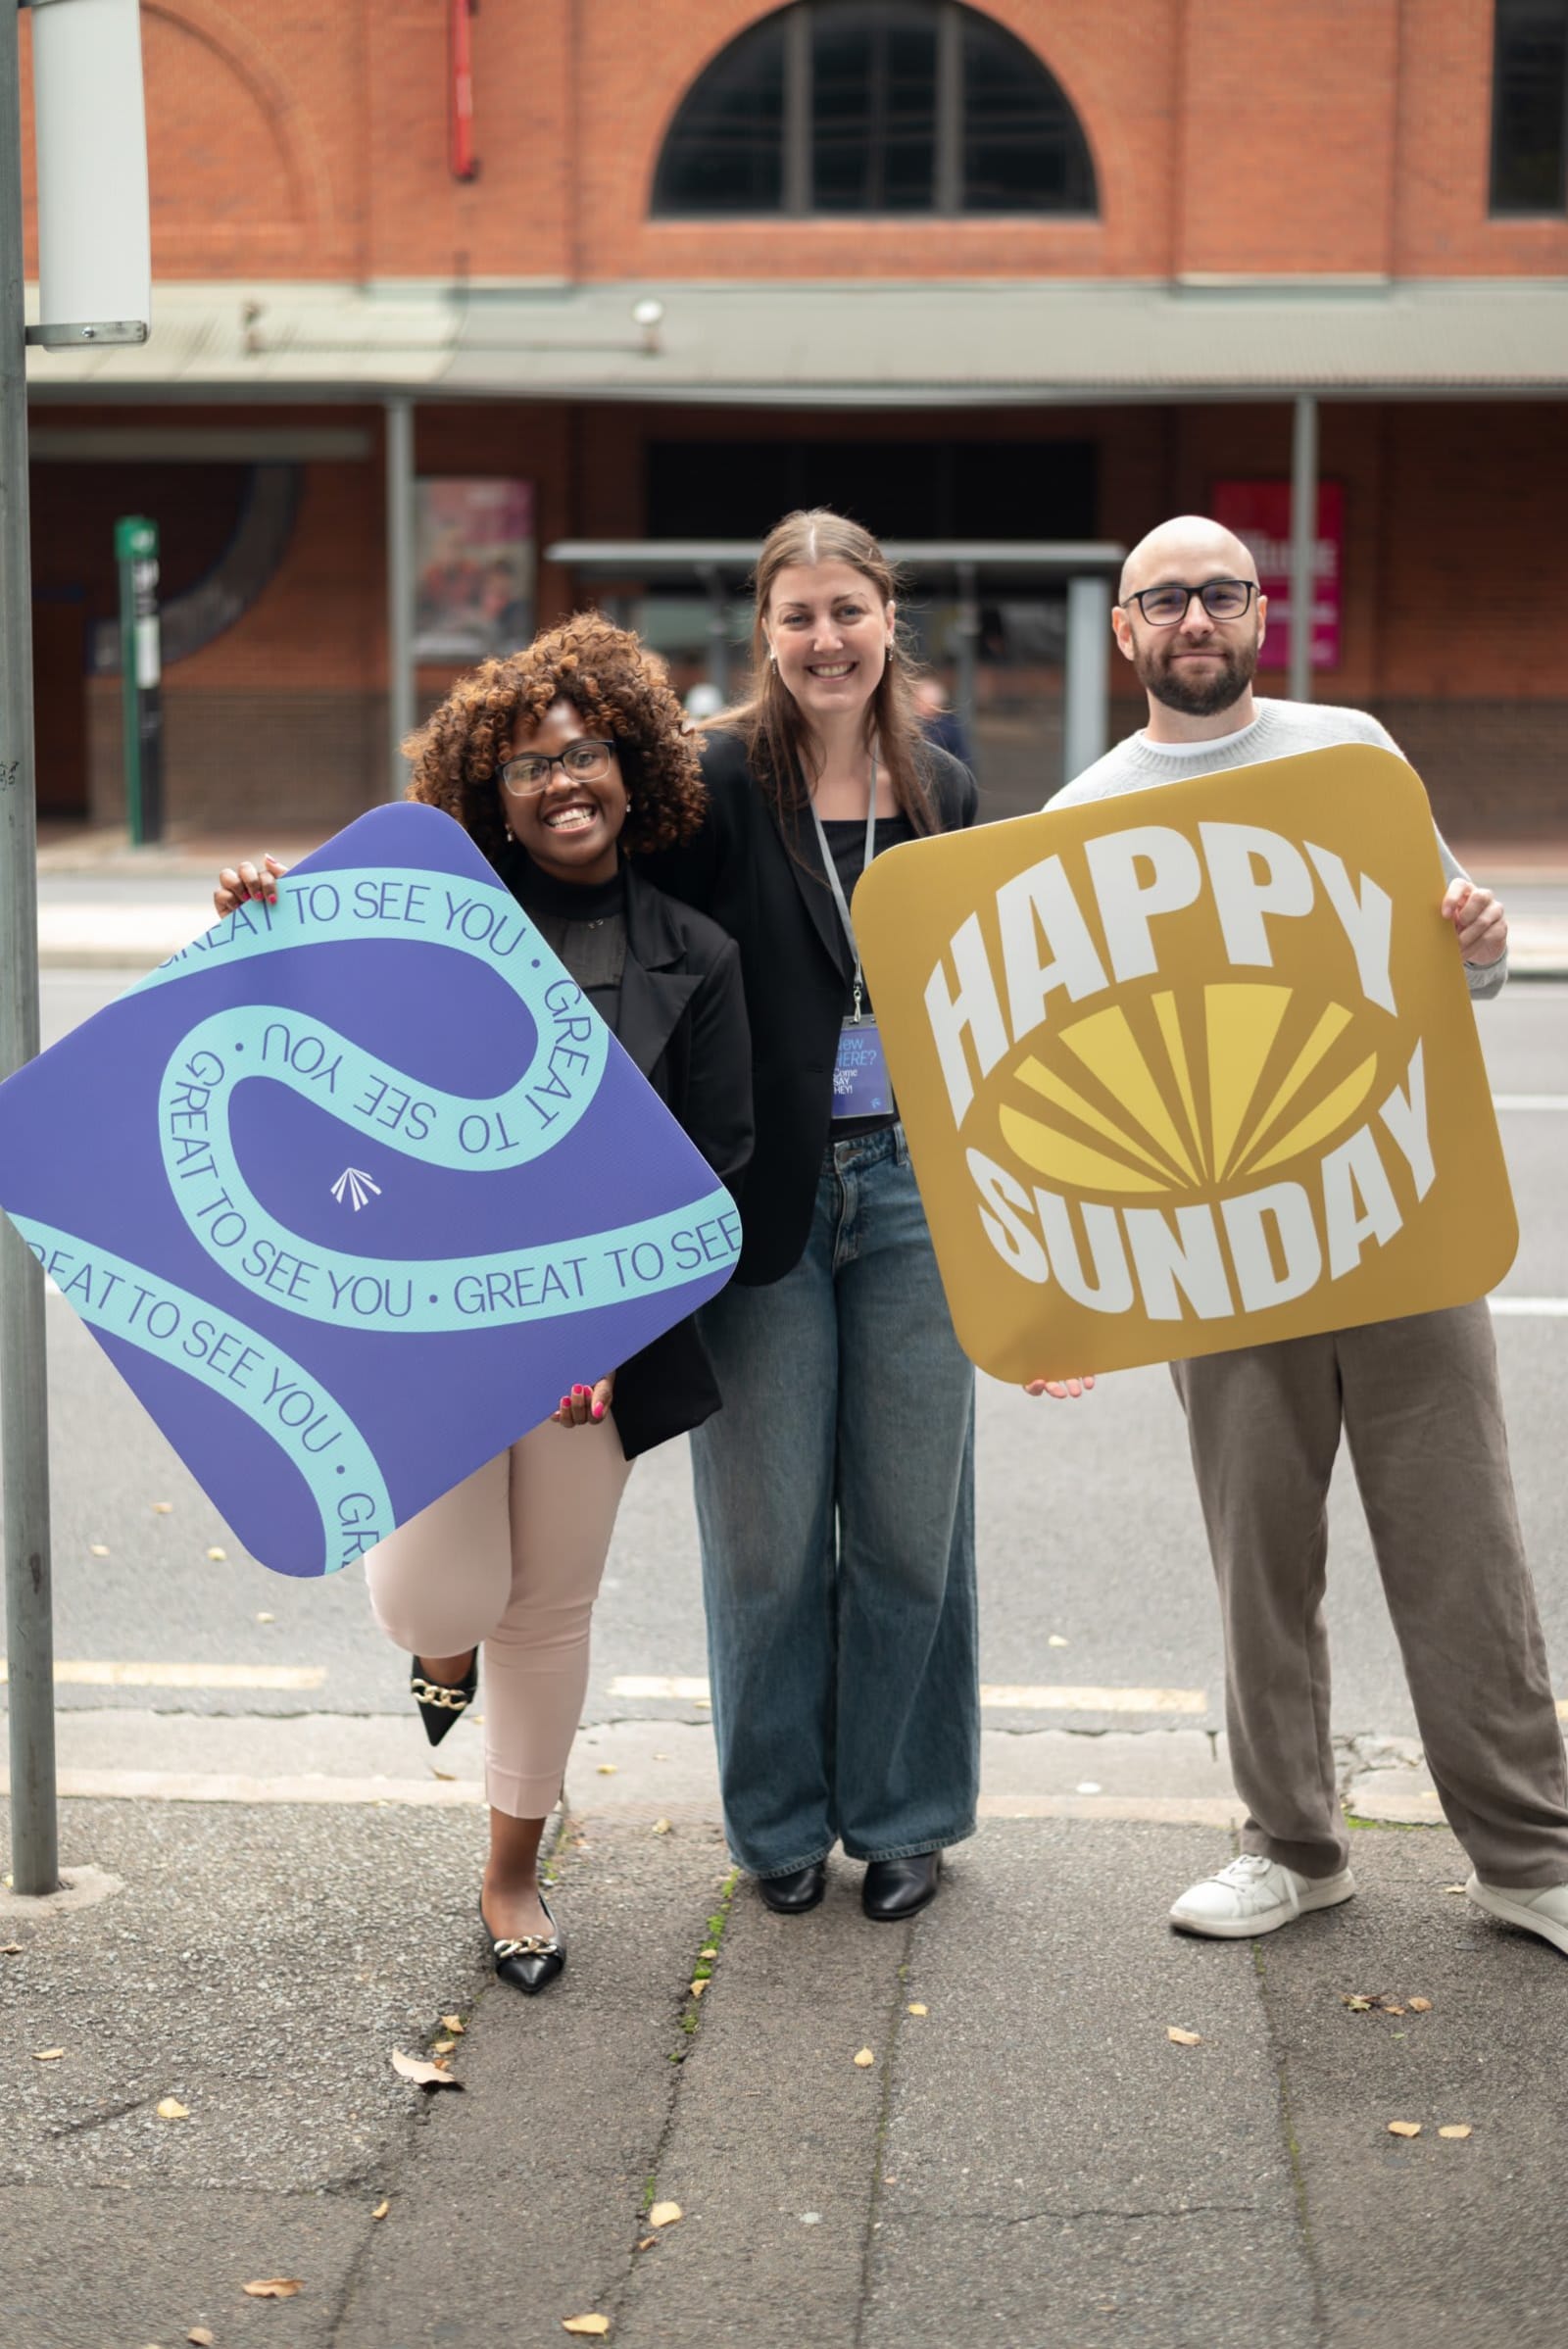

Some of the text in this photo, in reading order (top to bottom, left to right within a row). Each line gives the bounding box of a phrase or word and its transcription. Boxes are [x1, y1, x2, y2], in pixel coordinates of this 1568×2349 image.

[286, 884, 340, 925] TO
[352, 881, 431, 924] SEE
[445, 891, 526, 956] YOU
[924, 820, 1398, 1132] HAPPY
[262, 979, 592, 1153] GREAT TO SEE YOU
[833, 1068, 858, 1078] Come
[833, 1078, 851, 1087] SAY
[833, 1085, 853, 1095] HEY!
[170, 1051, 412, 1317] GREAT TO SEE YOU
[966, 1036, 1437, 1321] SUNDAY
[454, 1210, 740, 1314] GREAT TO SEE
[127, 1285, 180, 1339] TO
[182, 1320, 265, 1389] SEE
[263, 1367, 342, 1452] YOU
[337, 1493, 379, 1568] GR
